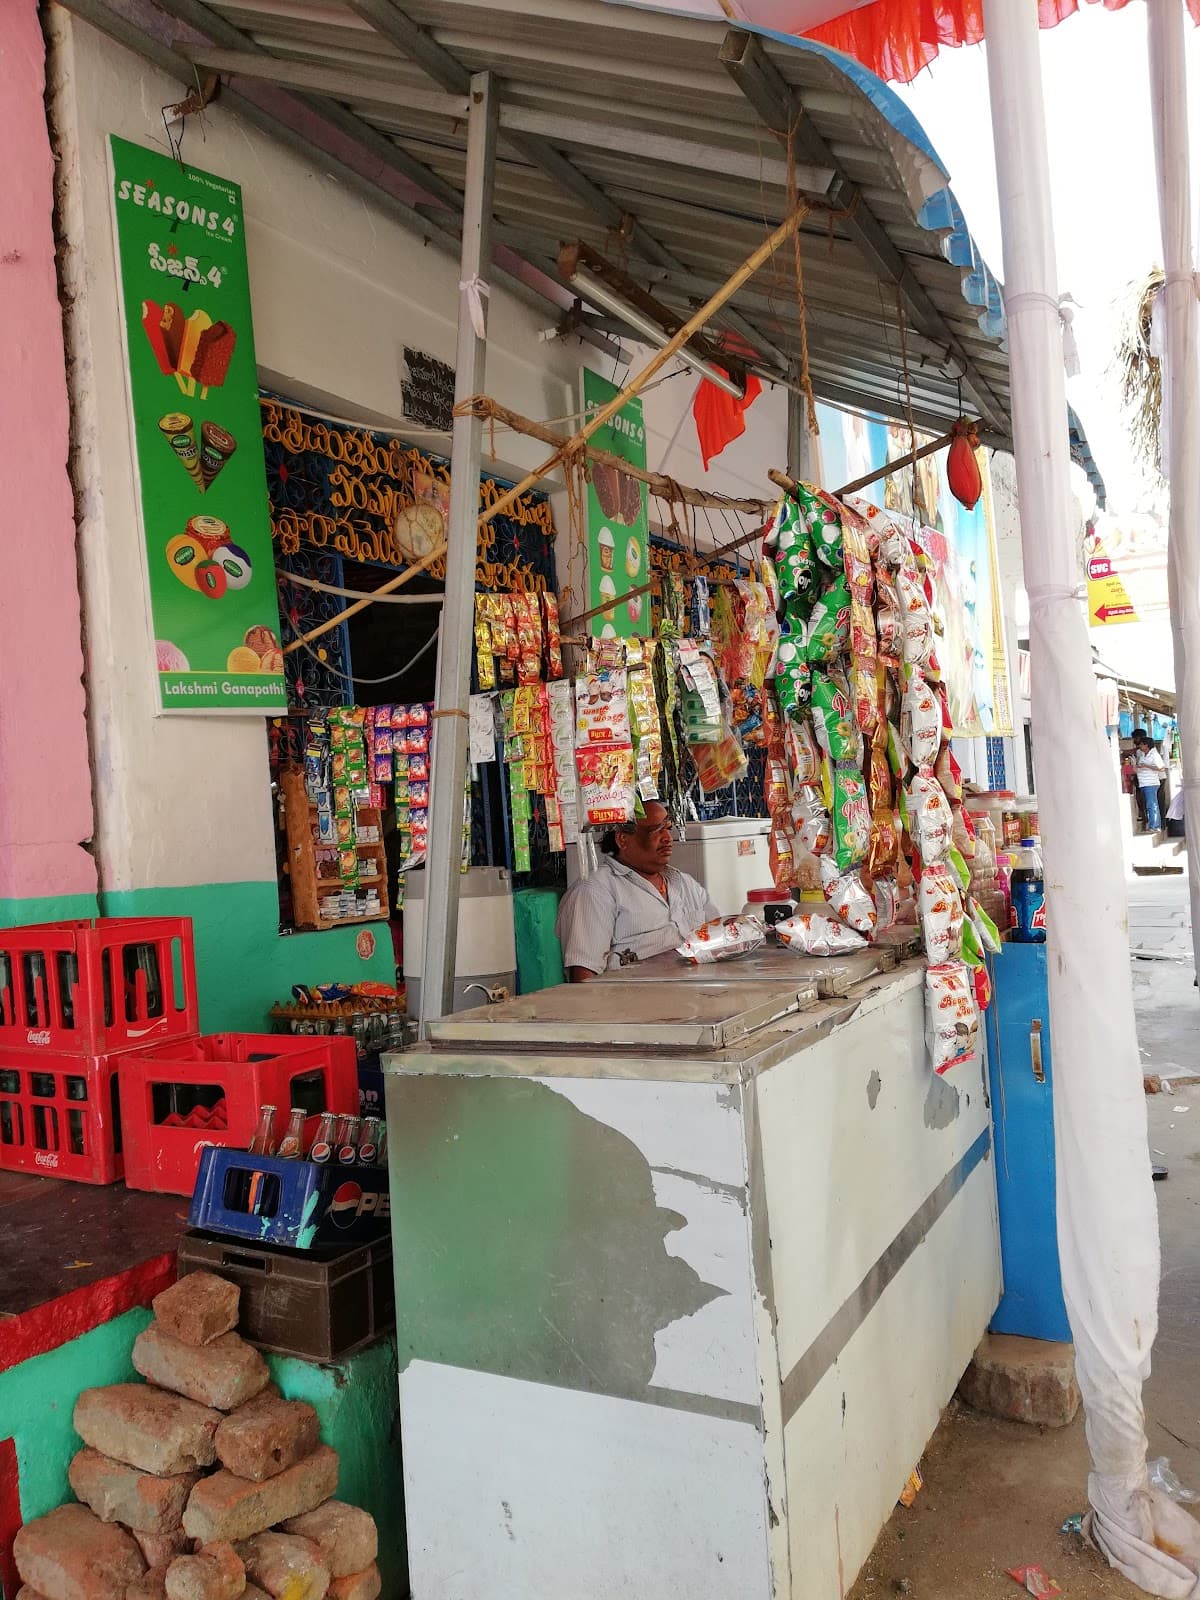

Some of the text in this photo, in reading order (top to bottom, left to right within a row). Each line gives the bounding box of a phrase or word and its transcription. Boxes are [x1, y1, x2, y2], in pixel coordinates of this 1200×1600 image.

[117, 180, 235, 236] SEASONS 4
[207, 265, 222, 288] 4
[1090, 563, 1109, 575] SVC
[164, 681, 284, 698] Lakshmi Ganapathi
[586, 789, 627, 807] Tomato
